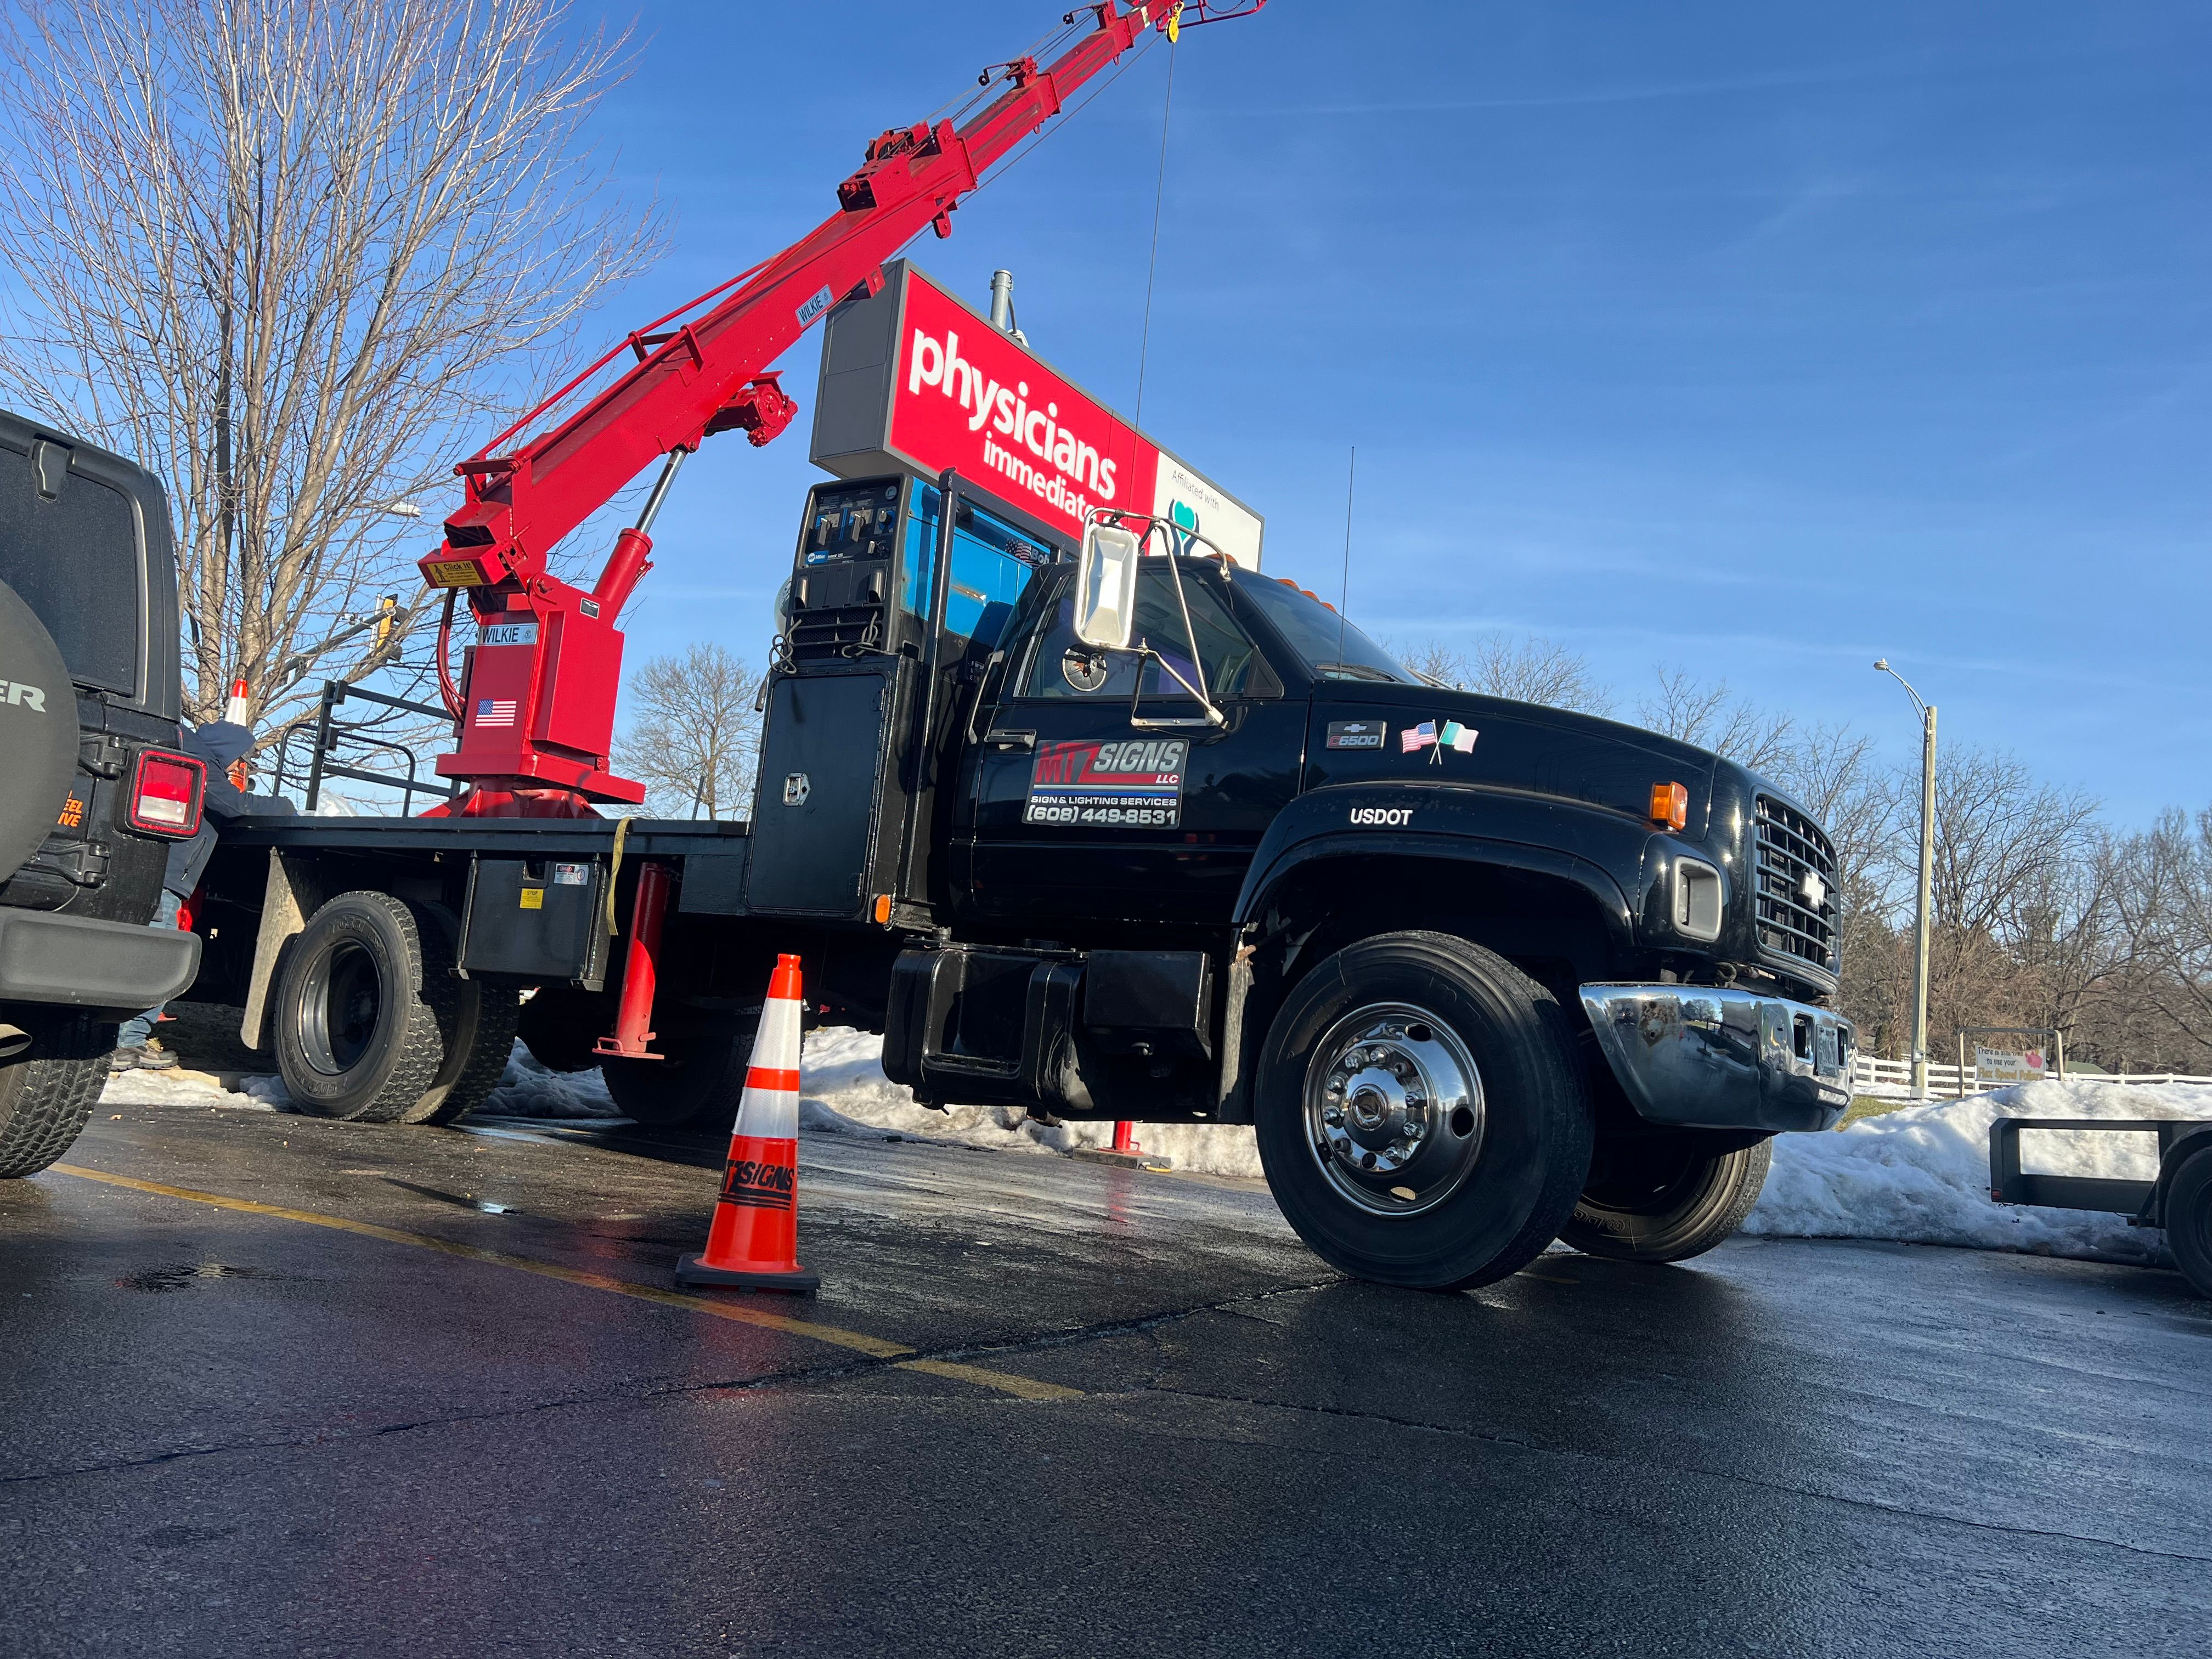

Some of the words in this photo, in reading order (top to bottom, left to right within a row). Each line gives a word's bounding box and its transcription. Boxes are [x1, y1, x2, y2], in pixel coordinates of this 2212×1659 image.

[799, 295, 823, 323] WILKIE
[909, 328, 1116, 500] physicians
[1172, 470, 1203, 500] Affiliated
[1204, 493, 1220, 511] with
[483, 627, 520, 643] WILKIE
[1328, 735, 1379, 746] C6500
[1093, 742, 1185, 772] SIGNS
[1155, 774, 1179, 784] LLC
[1031, 795, 1057, 804] SIGN
[1068, 797, 1118, 805] LIGHTING
[1120, 798, 1177, 806] SERVICES
[1026, 804, 1079, 823] (608)
[1081, 808, 1176, 825] 449-8531
[1350, 808, 1413, 826] USDOT
[1978, 1066, 1993, 1079] Flex
[738, 1161, 794, 1191] SIGNS
